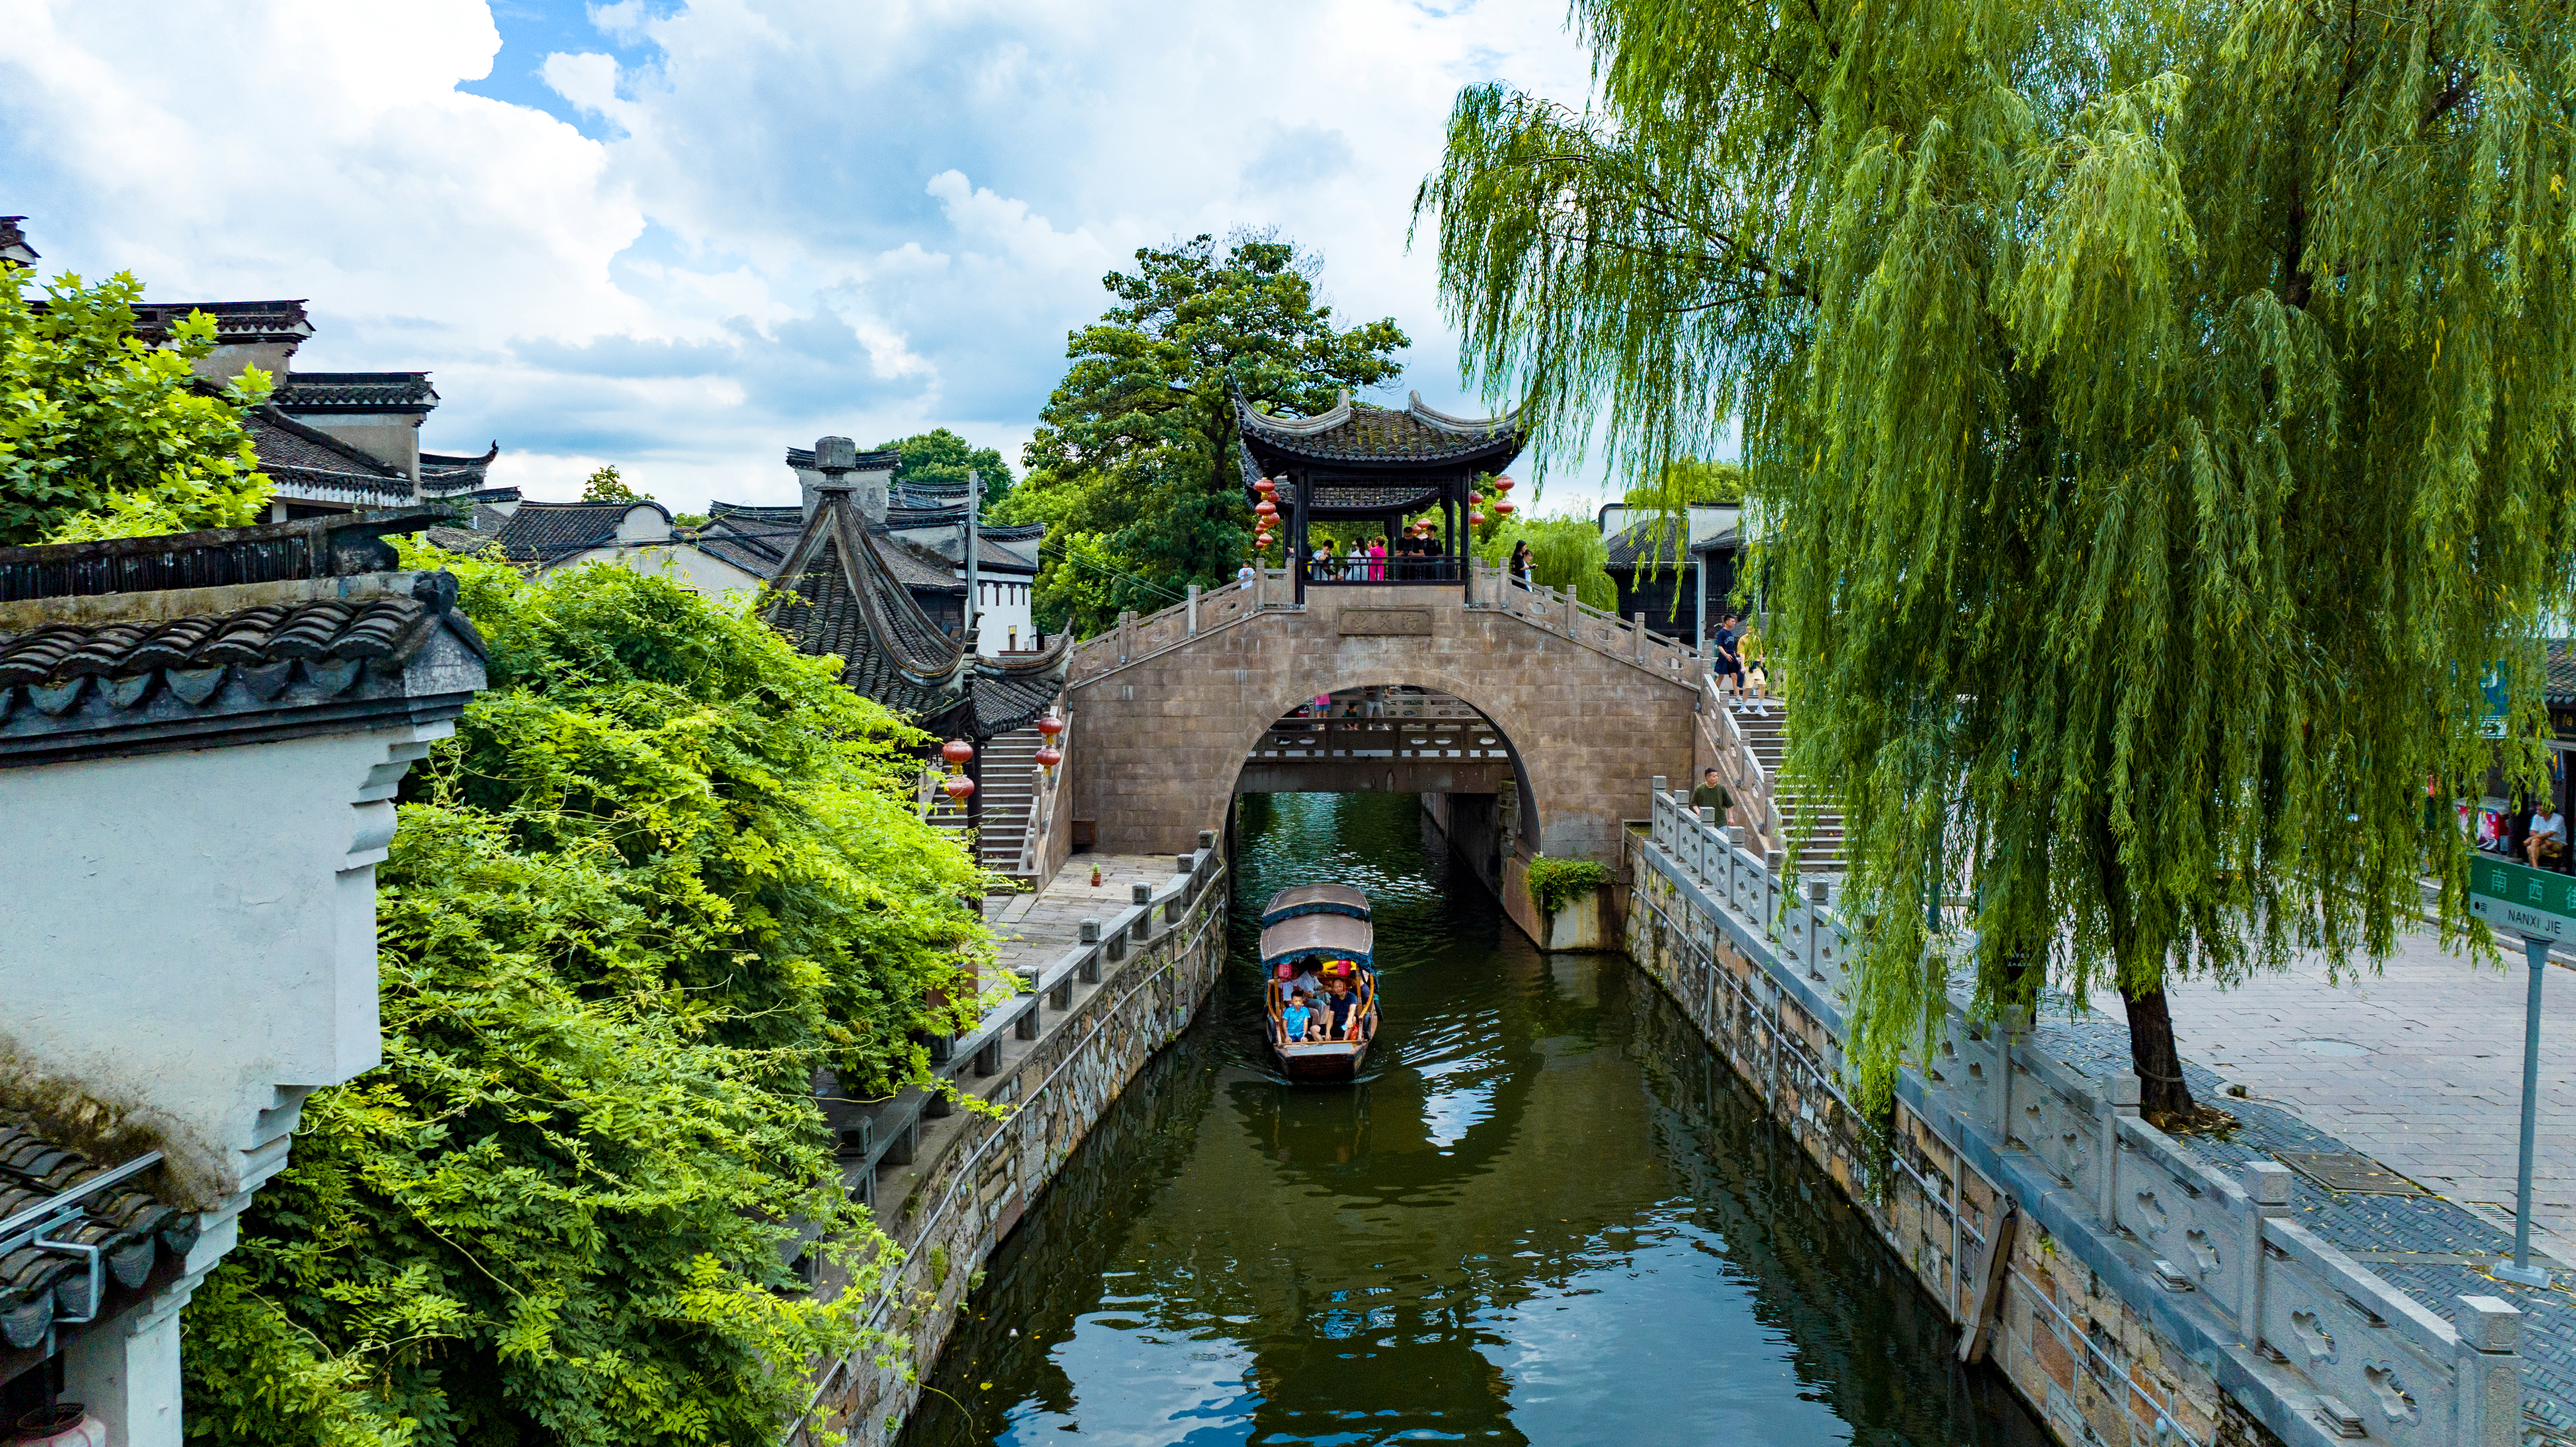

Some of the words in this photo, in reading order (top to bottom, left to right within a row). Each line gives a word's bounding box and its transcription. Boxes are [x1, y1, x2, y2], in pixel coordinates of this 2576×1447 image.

[2480, 902, 2488, 914] 南
[2508, 909, 2540, 929] NANXI
[2545, 920, 2561, 935] JIE
